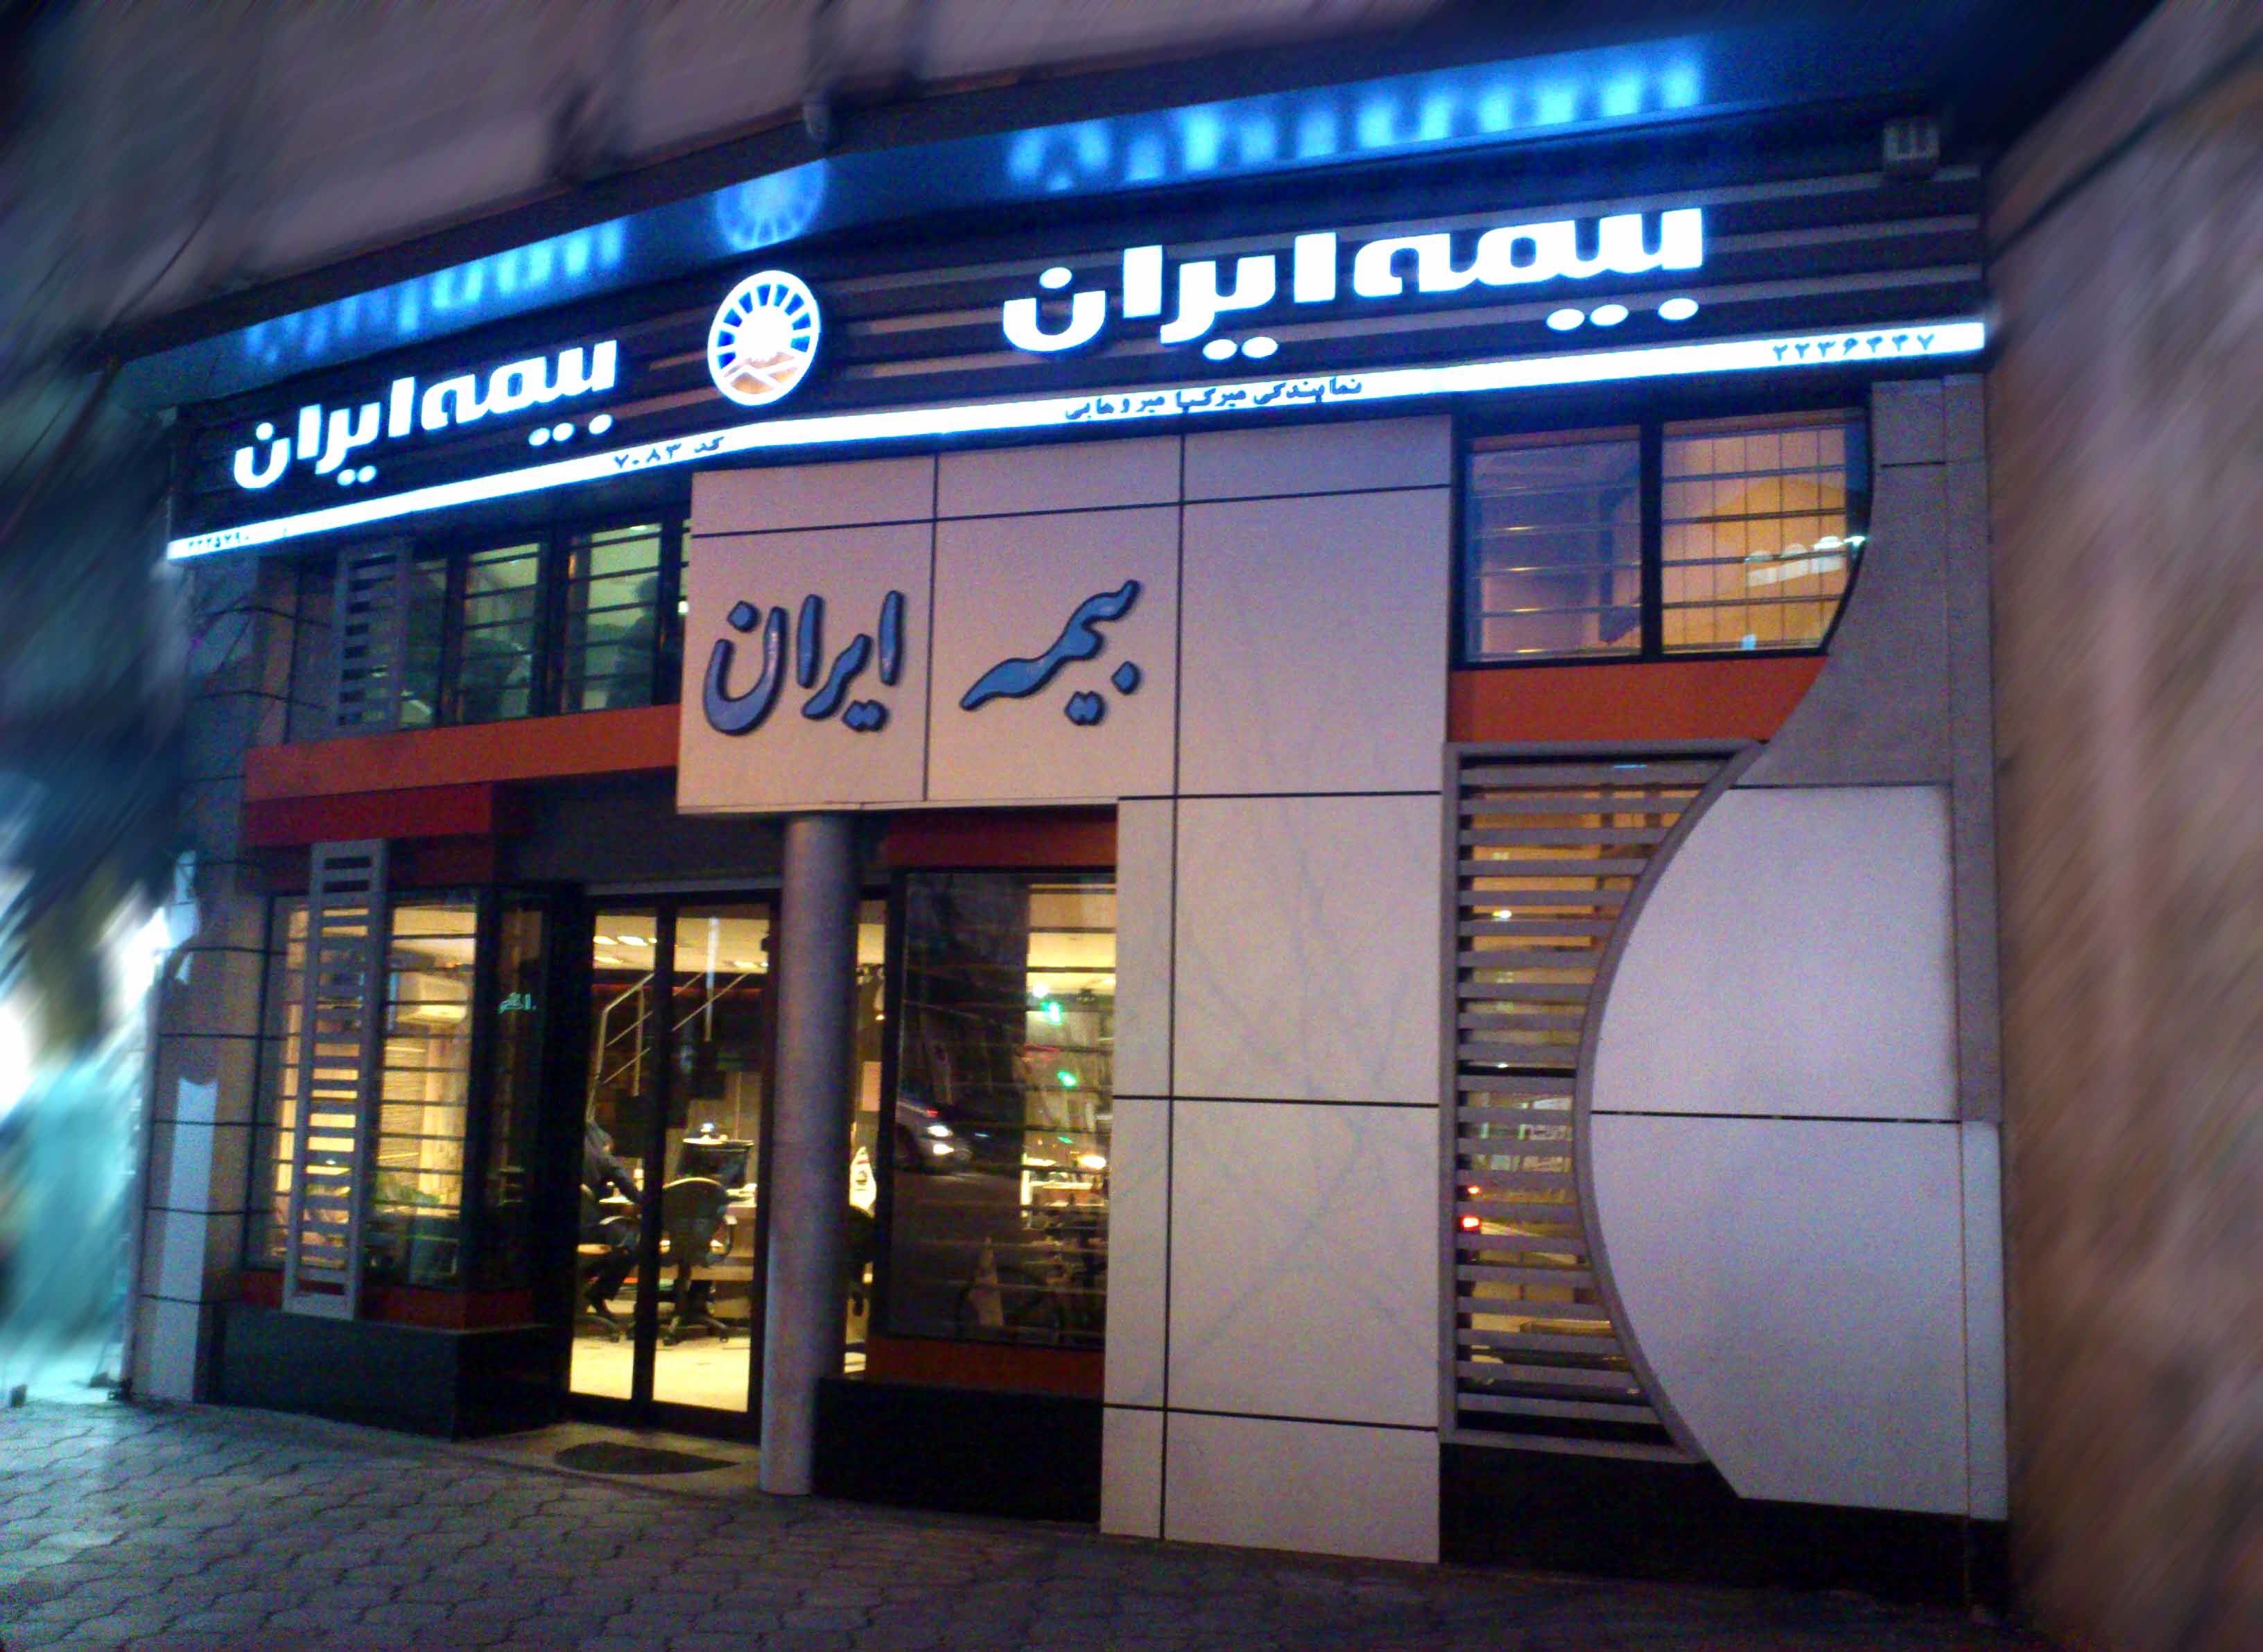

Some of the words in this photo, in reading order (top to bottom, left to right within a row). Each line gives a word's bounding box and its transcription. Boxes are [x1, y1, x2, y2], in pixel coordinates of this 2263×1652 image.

[1003, 232, 1337, 360] ایران
[1353, 208, 1703, 331] بیمه
[233, 376, 415, 489] ایران
[420, 339, 617, 447] بیمه
[694, 436, 725, 453] کد
[1253, 376, 1362, 405] نمایندگی
[614, 443, 682, 469] ۷۰۸۳
[702, 589, 905, 737] ایران
[959, 578, 1144, 727] بیمه
